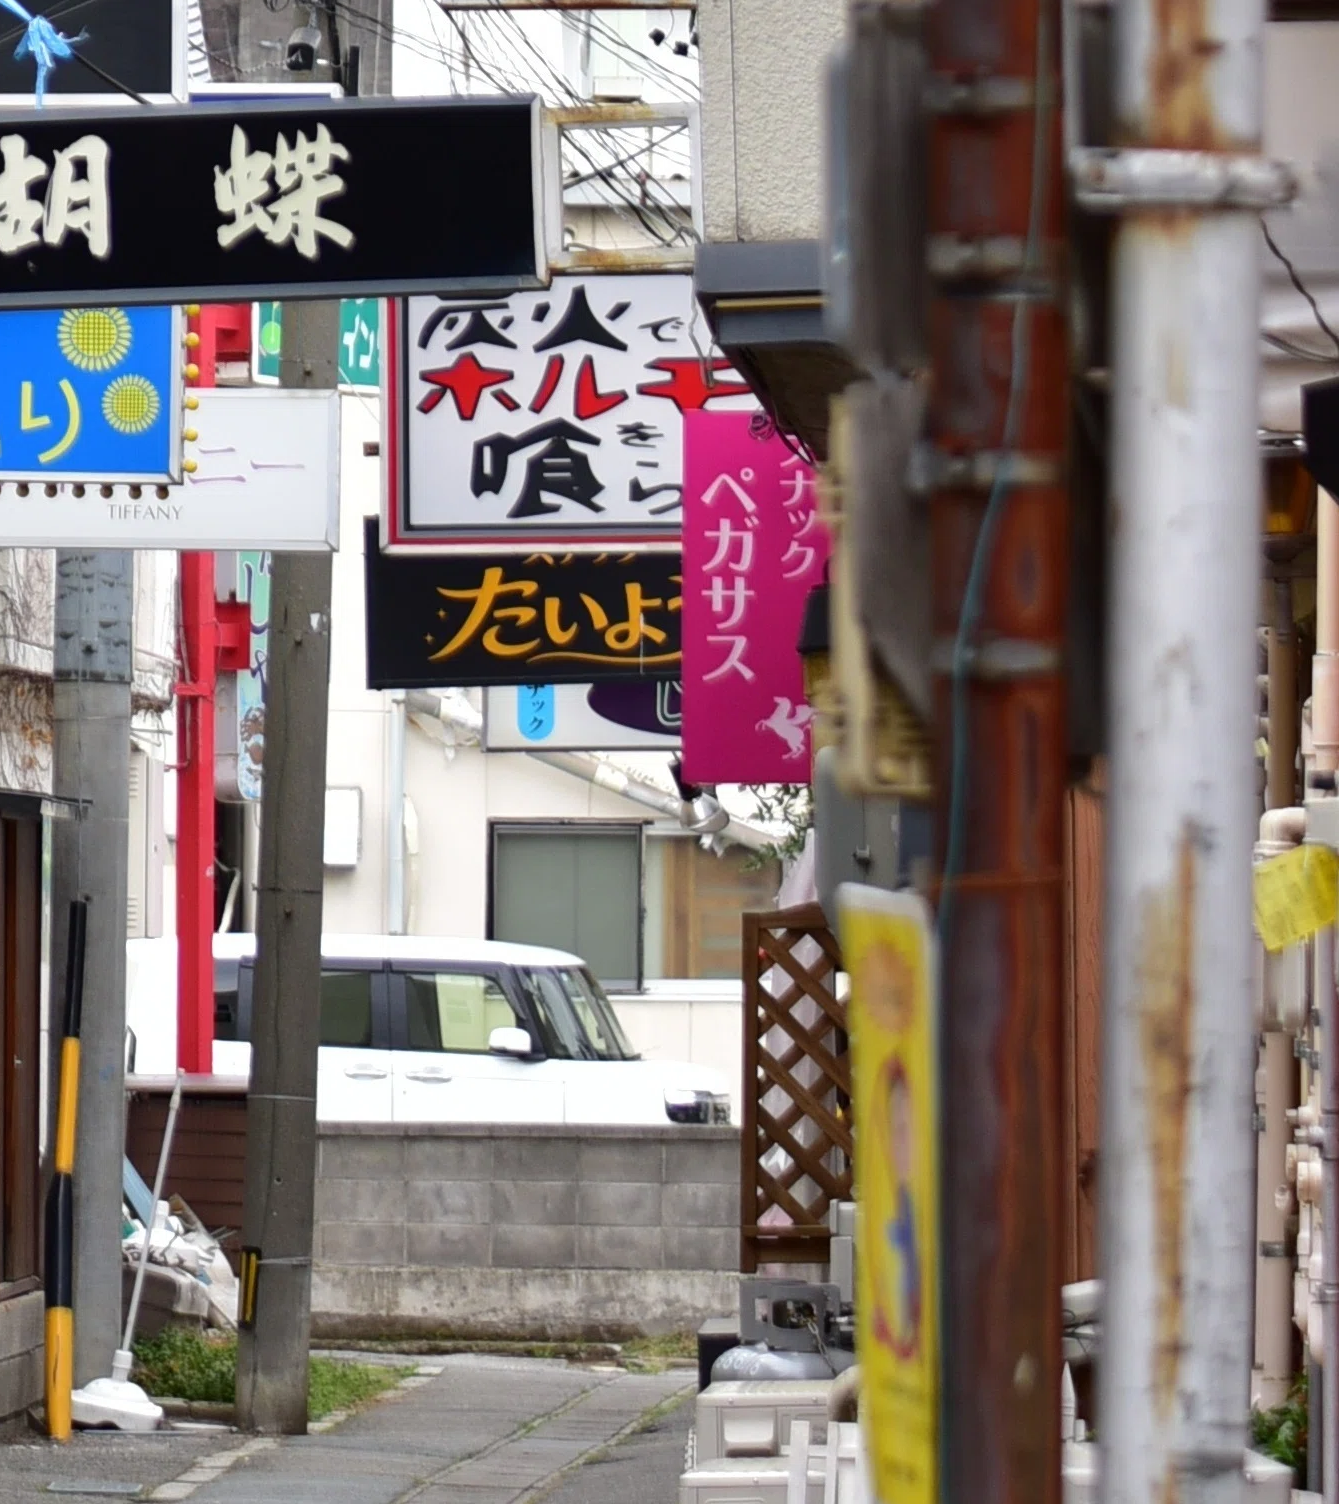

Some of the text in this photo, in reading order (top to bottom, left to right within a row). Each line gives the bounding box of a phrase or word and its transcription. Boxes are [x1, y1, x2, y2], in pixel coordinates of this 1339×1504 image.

[107, 503, 183, 520] TIFFANY
[430, 565, 682, 656] たいよ
[700, 467, 759, 684] ペガサス
